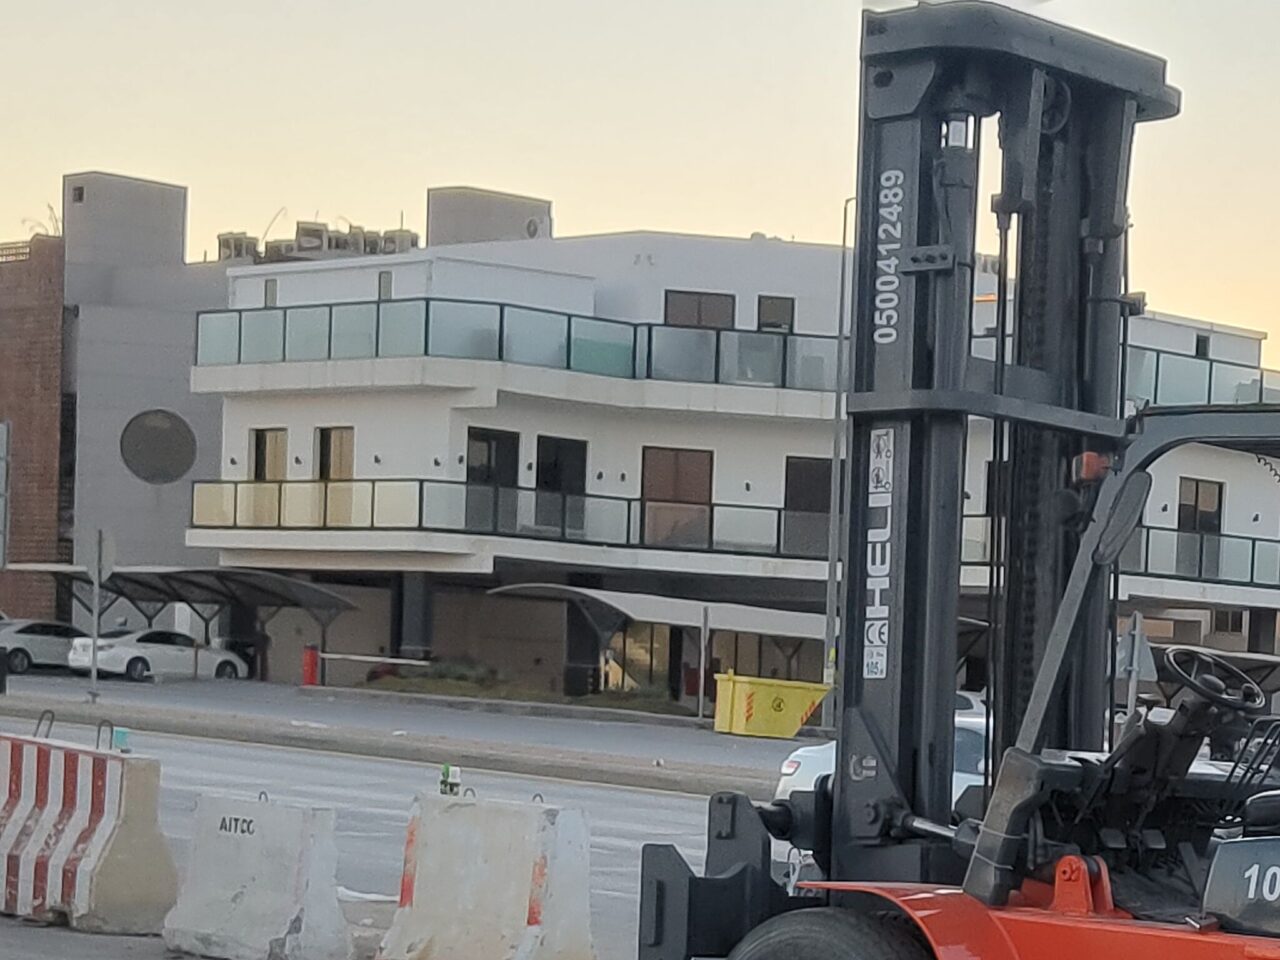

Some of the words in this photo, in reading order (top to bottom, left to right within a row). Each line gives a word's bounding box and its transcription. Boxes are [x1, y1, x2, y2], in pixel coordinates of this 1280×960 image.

[873, 169, 905, 345] 0500412489
[866, 493, 892, 618] HELI
[866, 623, 887, 644] CE
